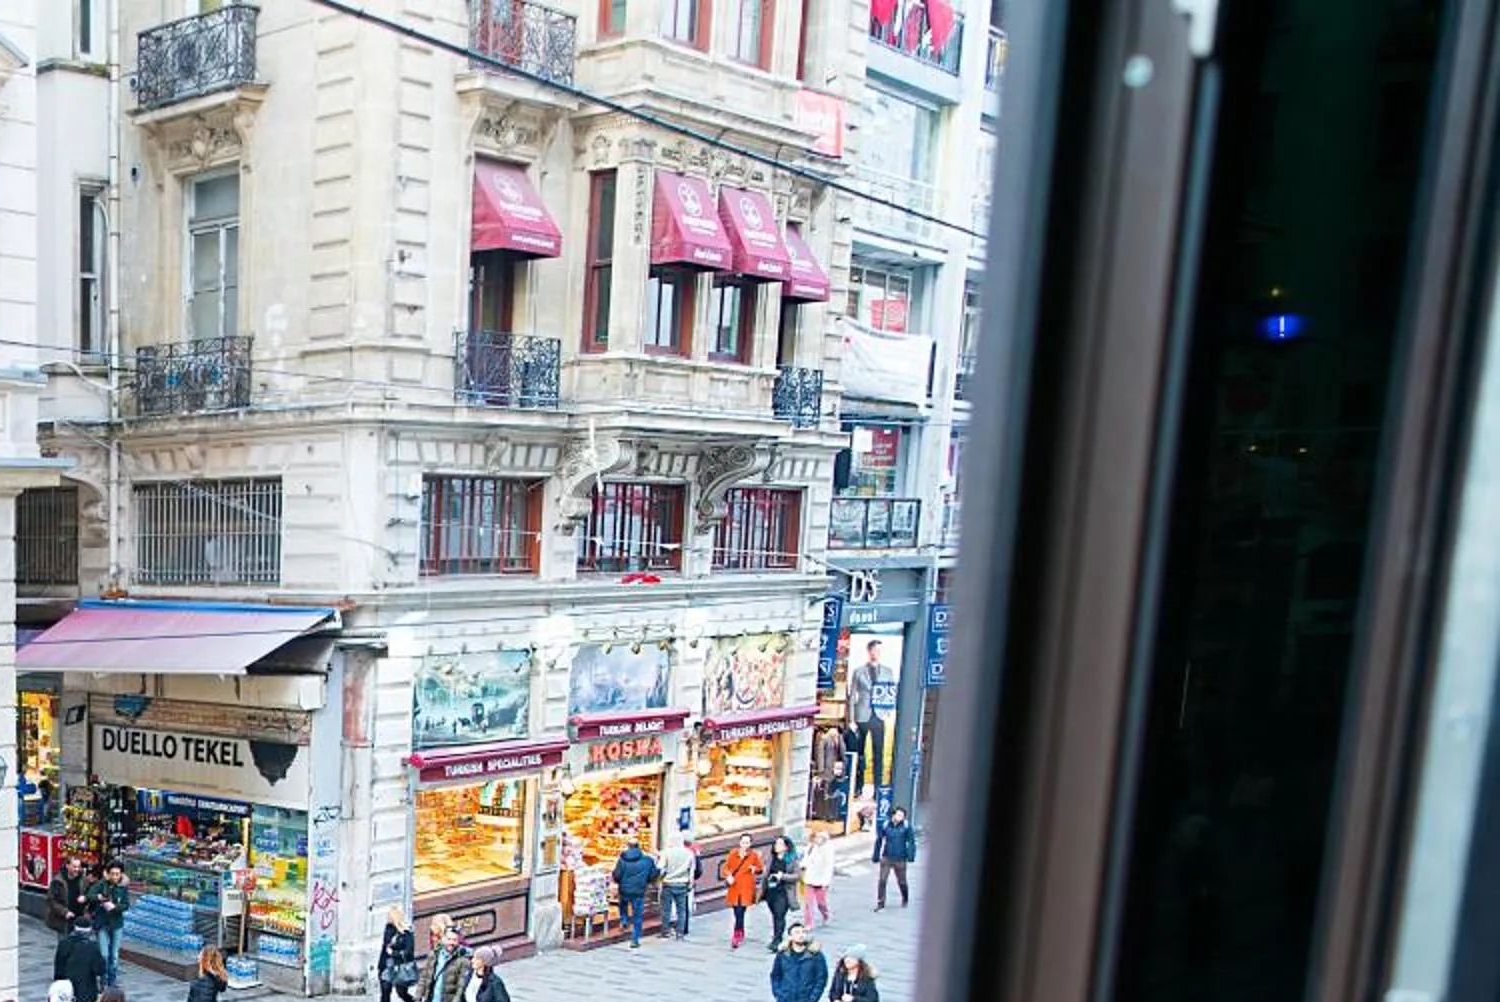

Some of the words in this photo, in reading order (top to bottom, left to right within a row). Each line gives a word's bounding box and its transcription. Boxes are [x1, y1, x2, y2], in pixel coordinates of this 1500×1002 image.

[182, 737, 244, 767] TEKEL
[591, 736, 663, 762] KOSKA
[445, 762, 484, 777] TURKISH
